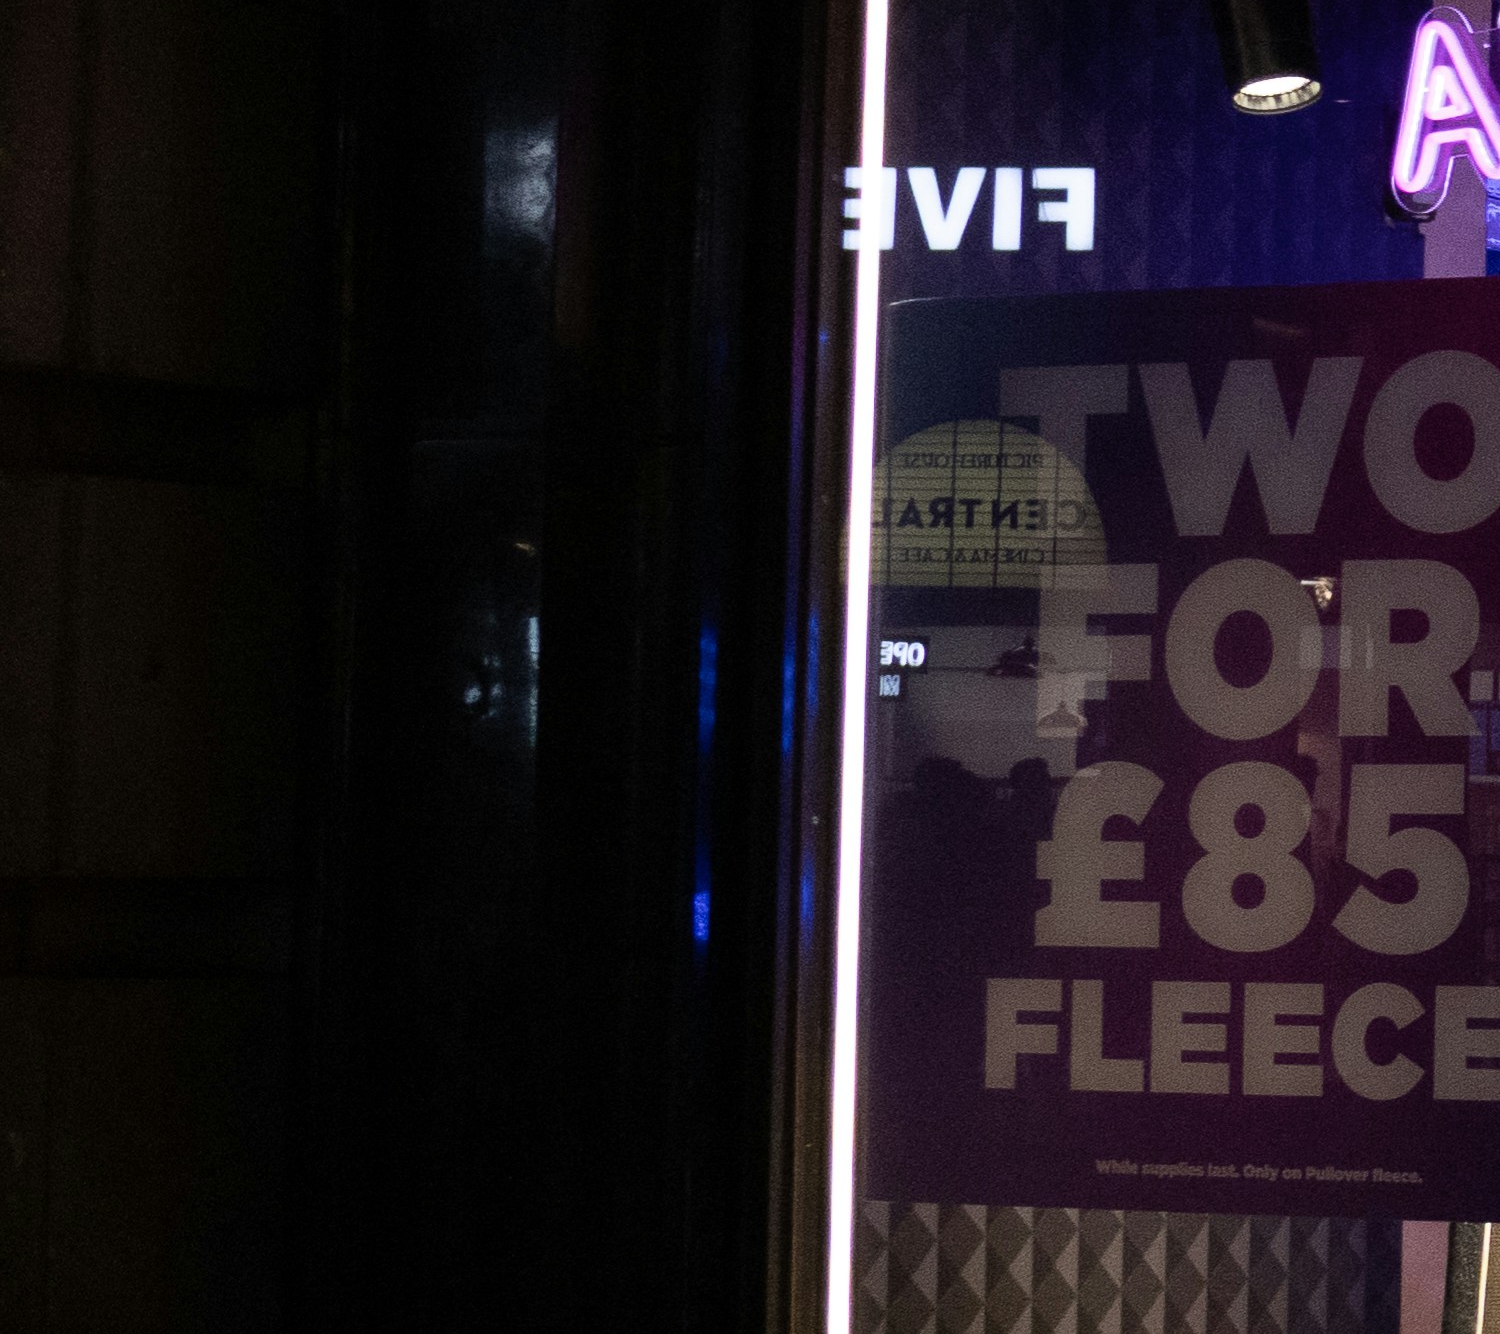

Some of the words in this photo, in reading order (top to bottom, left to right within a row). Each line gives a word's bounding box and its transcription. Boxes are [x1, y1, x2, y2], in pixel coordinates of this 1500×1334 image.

[1036, 558, 1483, 740] FOR
[1034, 762, 1470, 955] £85
[1096, 1159, 1137, 1174] While
[1141, 1162, 1203, 1179] supplies
[1207, 1162, 1239, 1178] last.
[1243, 1163, 1279, 1182] Only
[1282, 1168, 1302, 1180] on
[1305, 1166, 1369, 1182] Pullover
[1373, 1167, 1423, 1184] fleece.
